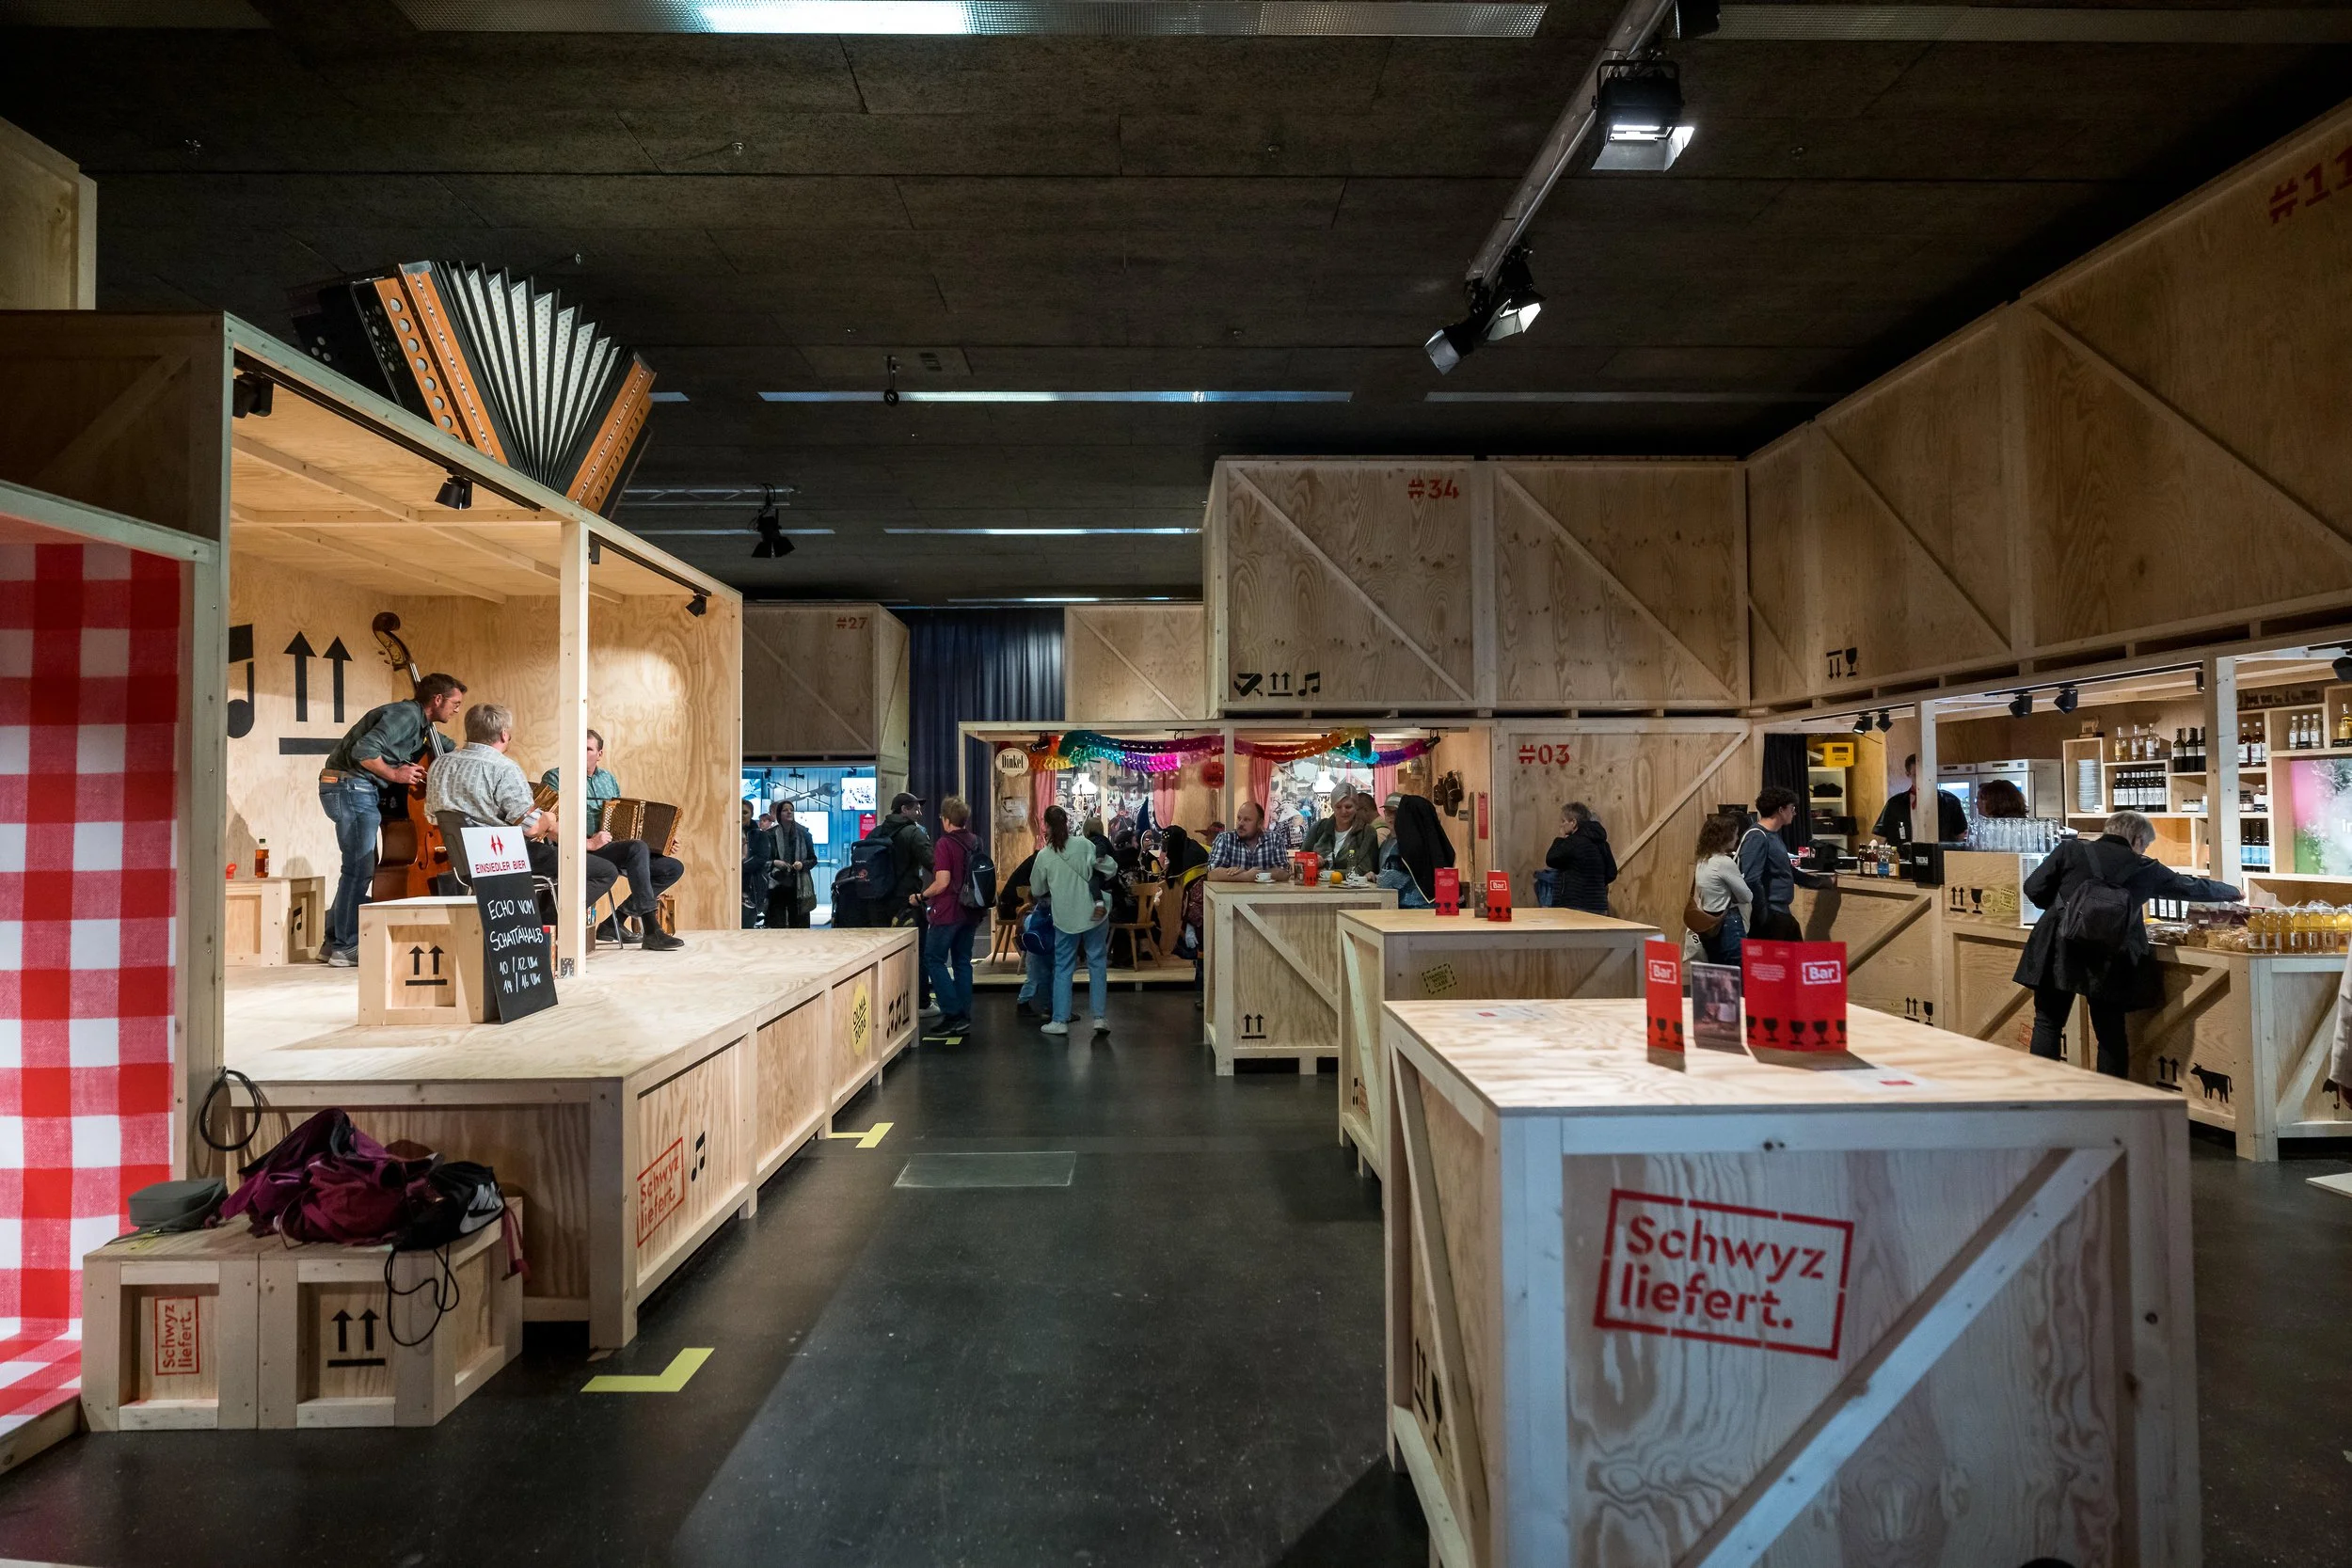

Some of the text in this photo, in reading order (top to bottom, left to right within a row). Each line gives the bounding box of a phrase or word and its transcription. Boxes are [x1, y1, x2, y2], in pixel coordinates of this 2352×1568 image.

[1407, 479, 1460, 499] #34
[835, 616, 868, 629] #27
[1001, 753, 1024, 769] Dinkel
[1518, 744, 1570, 765] #03
[475, 860, 527, 874] EINSIEDLER BIER
[487, 898, 535, 920] ECHO VOM
[1653, 965, 1672, 979] Bar
[1808, 966, 1836, 980] Bar
[640, 1154, 679, 1204] Schwyz
[1626, 1214, 1827, 1284] Schwyz
[1619, 1262, 1793, 1329] liefert.
[161, 1305, 178, 1369] Schwyz
[177, 1311, 193, 1368] liefert.
